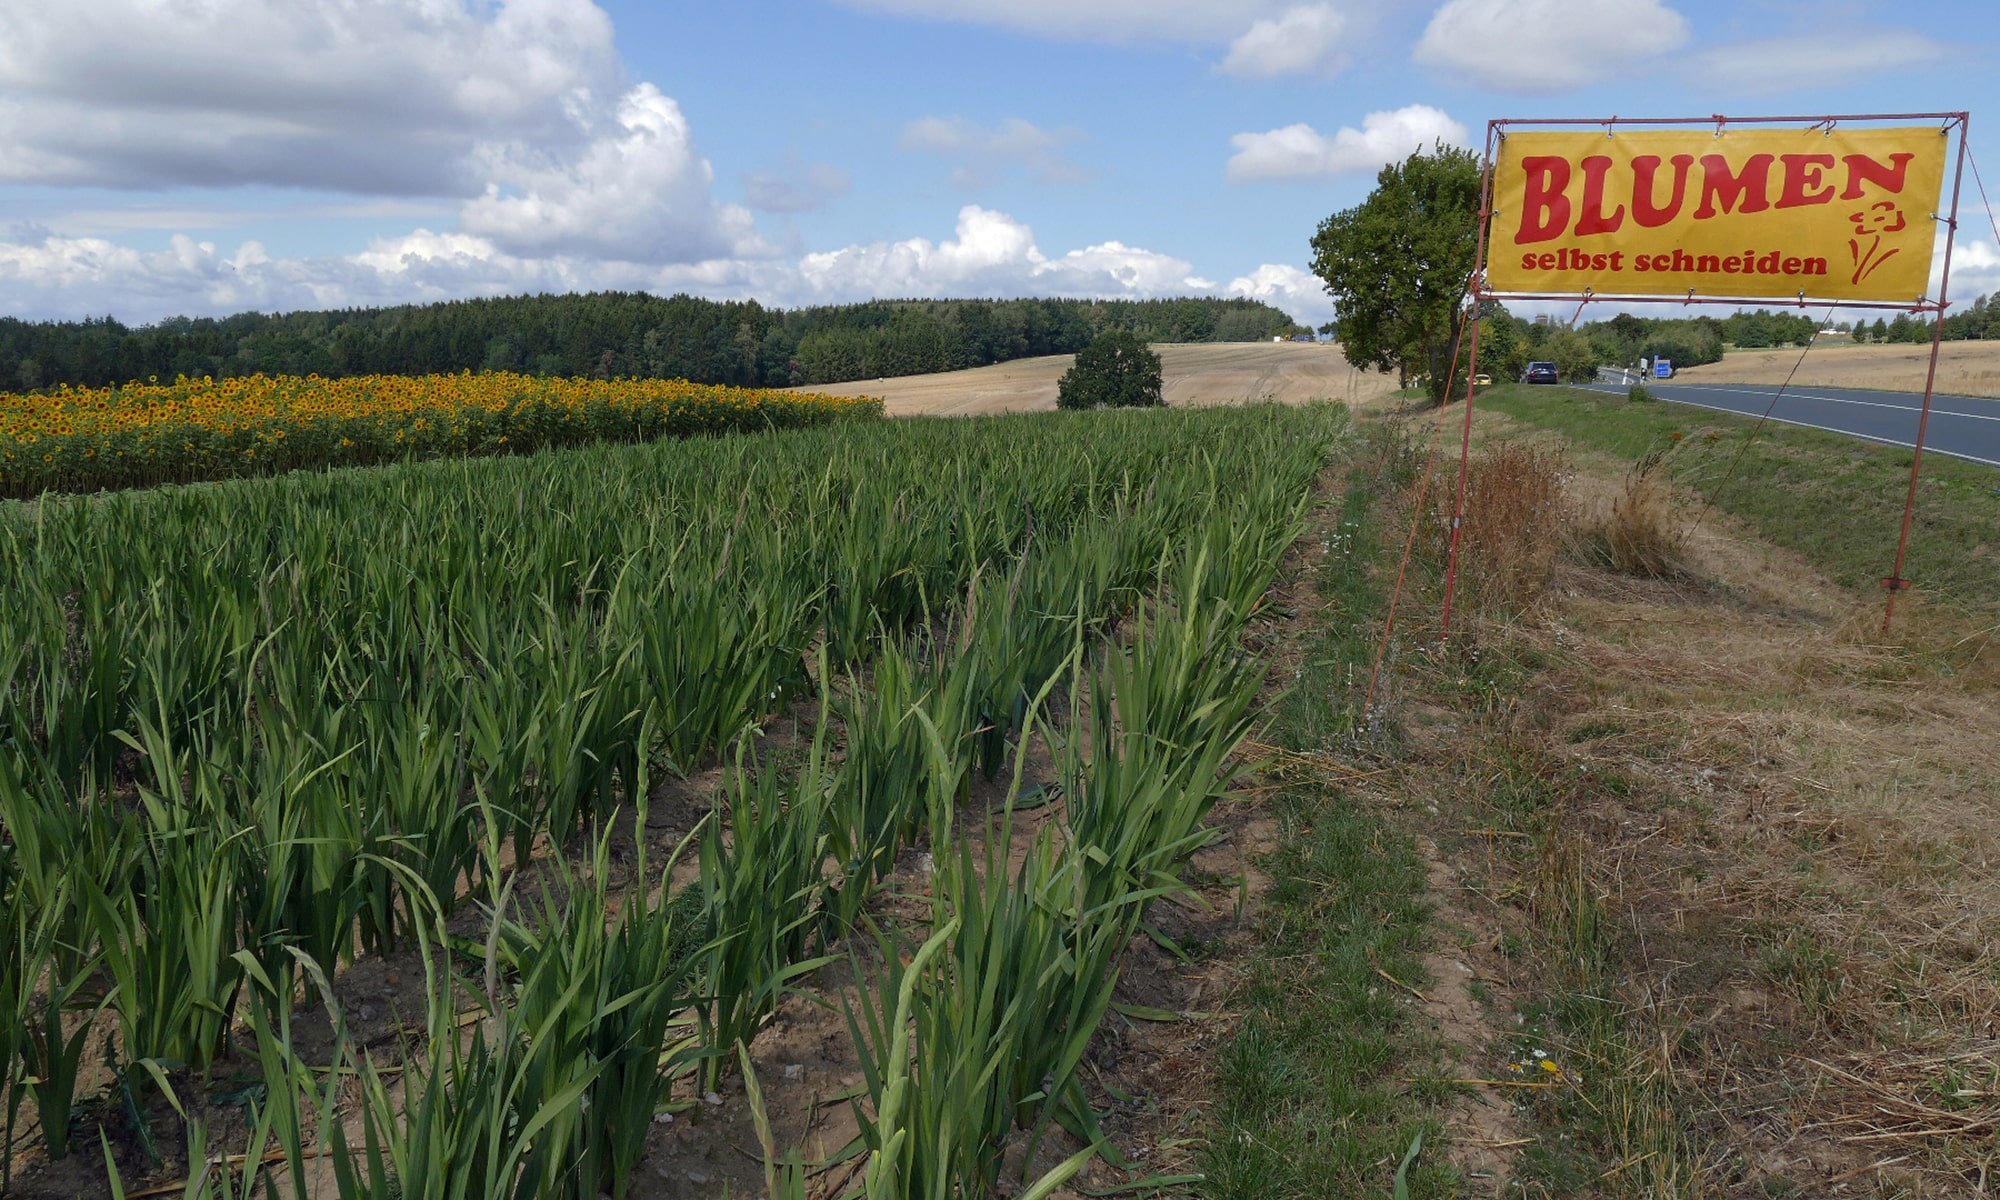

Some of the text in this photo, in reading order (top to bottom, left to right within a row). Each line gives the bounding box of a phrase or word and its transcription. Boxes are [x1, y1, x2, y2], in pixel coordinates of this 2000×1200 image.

[1514, 152, 1915, 245] BLUMEN
[1521, 247, 1828, 275] selbst schneiden
